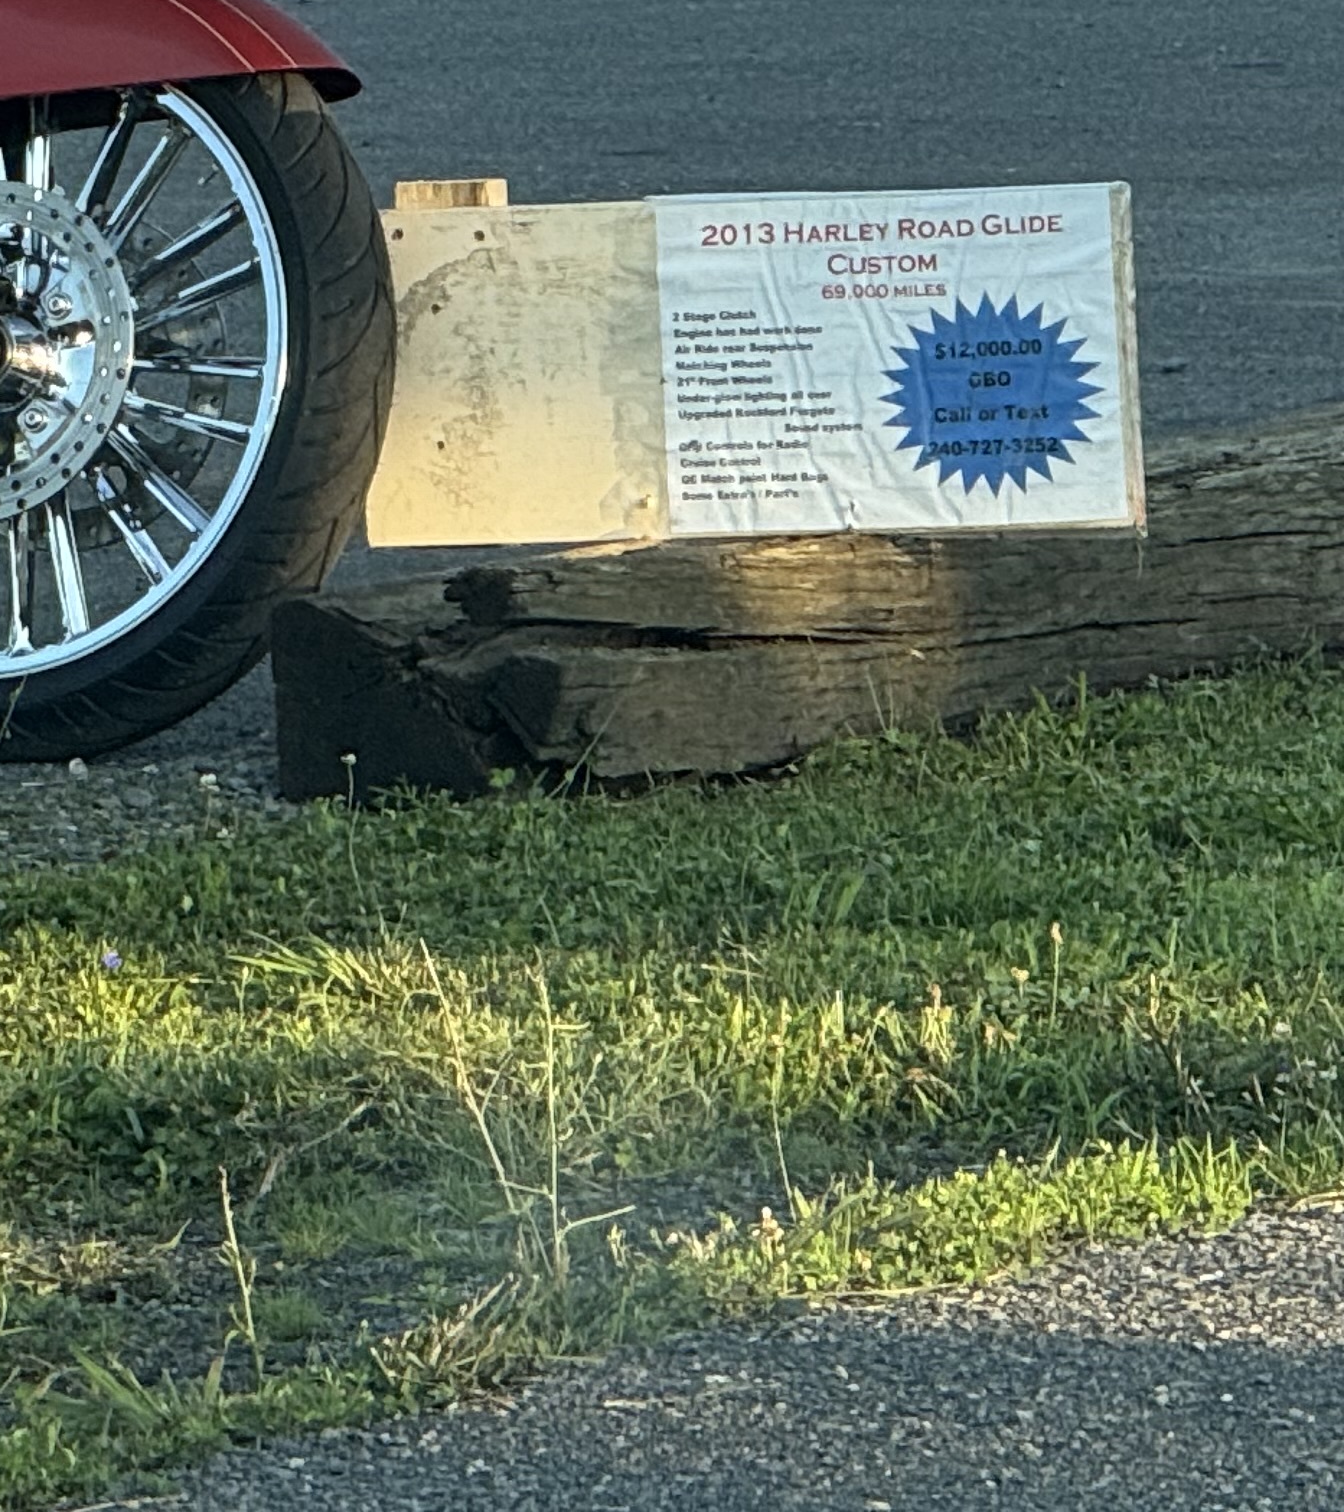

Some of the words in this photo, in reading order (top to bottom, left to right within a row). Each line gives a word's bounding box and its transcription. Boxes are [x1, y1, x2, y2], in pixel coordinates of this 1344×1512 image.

[701, 223, 776, 247] 2013
[784, 222, 889, 243] HARLEY
[898, 218, 975, 239] ROAD
[981, 214, 1063, 235] GLIDE
[827, 253, 938, 275] CUSTOM
[821, 283, 889, 300] 69,000
[894, 283, 947, 298] MILES
[672, 312, 680, 322] 2
[683, 312, 716, 323] Stage
[719, 310, 756, 320] Clutch
[673, 328, 713, 340] Engine
[716, 327, 736, 336] has
[739, 326, 760, 336] had
[763, 326, 792, 335] work
[794, 325, 823, 334] done
[675, 344, 691, 354] Air
[694, 344, 719, 354] Ride
[722, 344, 746, 354] rear
[935, 339, 1042, 360] $12,000.00
[675, 361, 728, 372] Matching
[730, 359, 772, 369] Wheels
[697, 376, 729, 386] Front
[677, 409, 733, 421] Upgraded
[934, 407, 972, 424] Call
[978, 409, 997, 420] or
[1003, 405, 1050, 420] Text
[784, 423, 819, 433] Sound
[821, 423, 863, 434] system
[706, 441, 754, 451] Controls
[756, 440, 774, 450] for
[680, 458, 716, 468] Cruise
[719, 456, 761, 467] Control
[771, 473, 797, 482] Hard
[801, 472, 829, 483] Bags
[682, 491, 713, 501] Some
